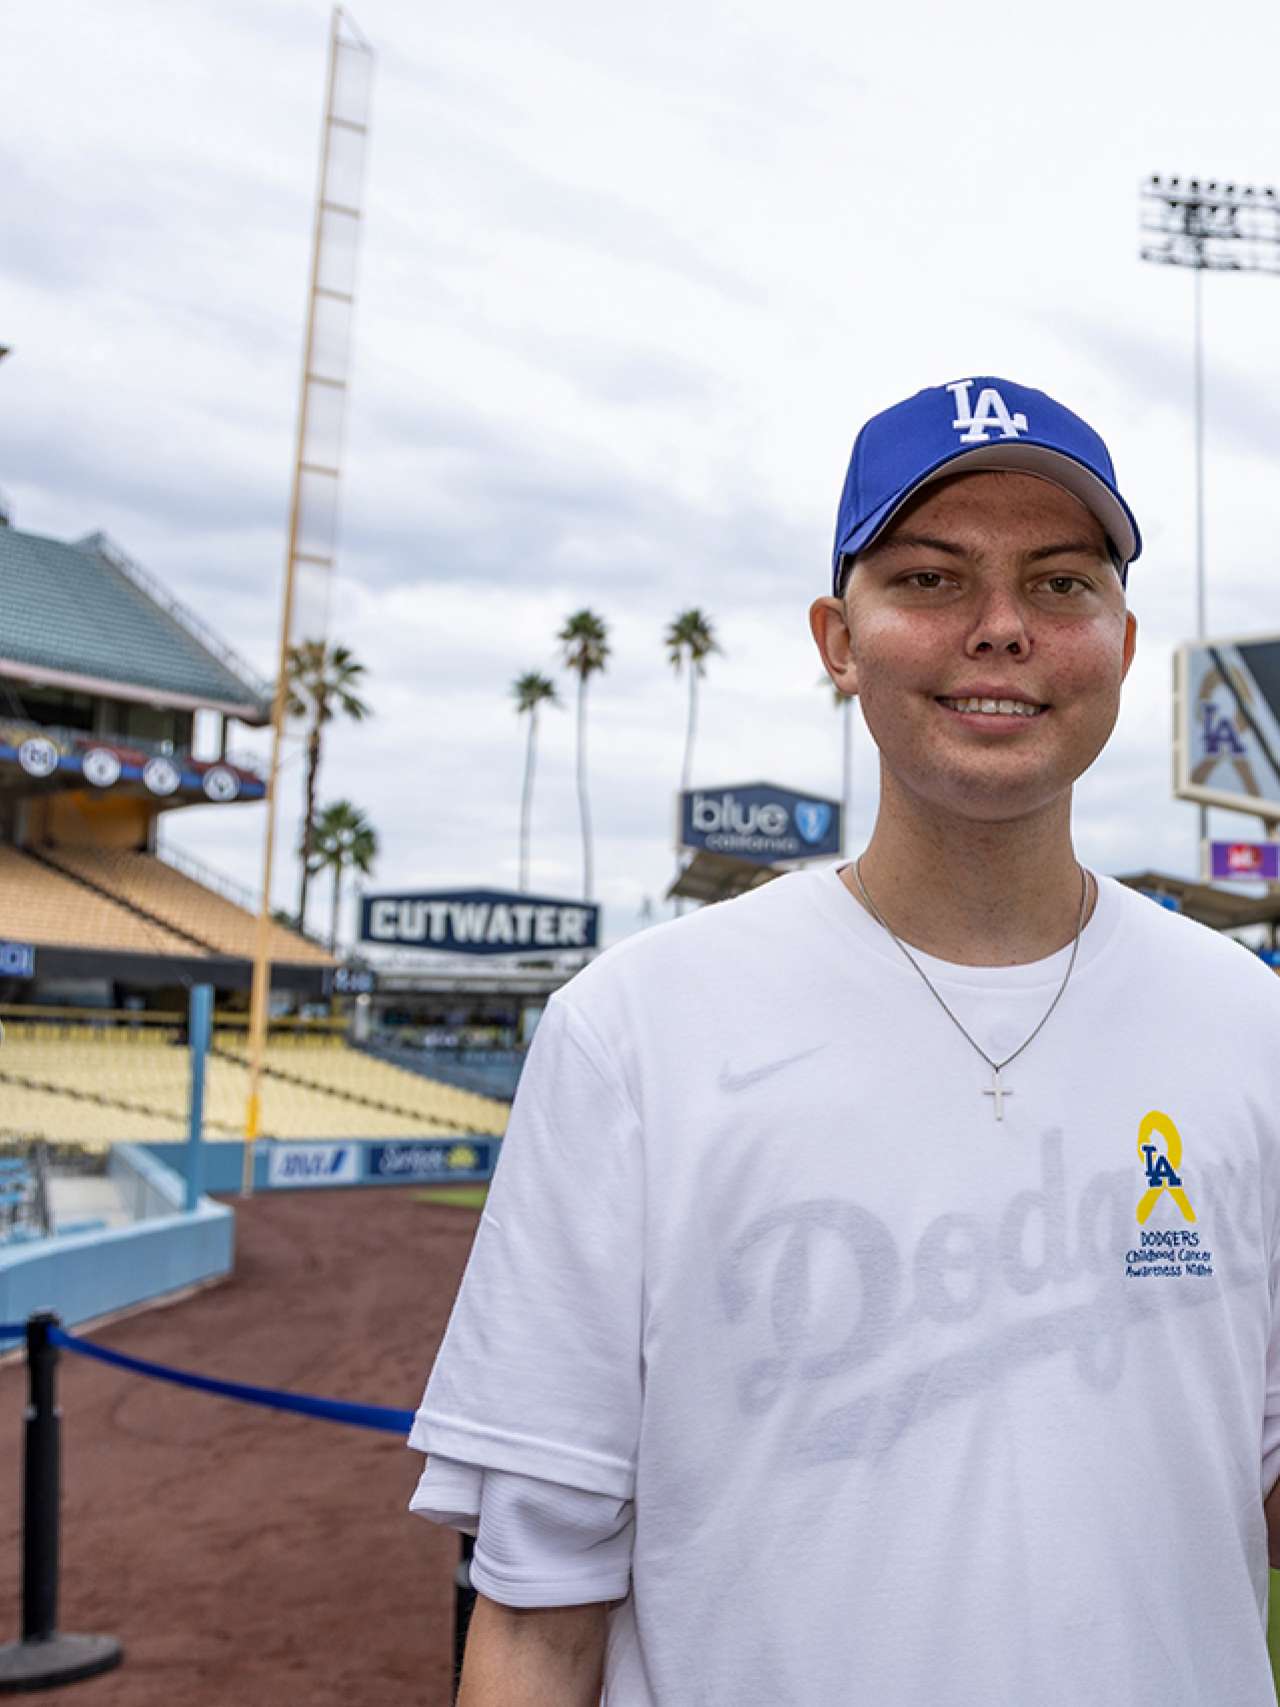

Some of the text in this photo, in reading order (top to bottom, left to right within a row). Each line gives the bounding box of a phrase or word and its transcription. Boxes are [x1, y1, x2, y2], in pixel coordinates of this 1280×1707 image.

[946, 380, 1028, 442] LA
[692, 792, 789, 836] blue
[369, 900, 588, 945] CUTWATER
[1142, 1144, 1182, 1187] LA
[1126, 1249, 1212, 1263] Childhood Cancer
[1141, 1230, 1200, 1247] DODGERS
